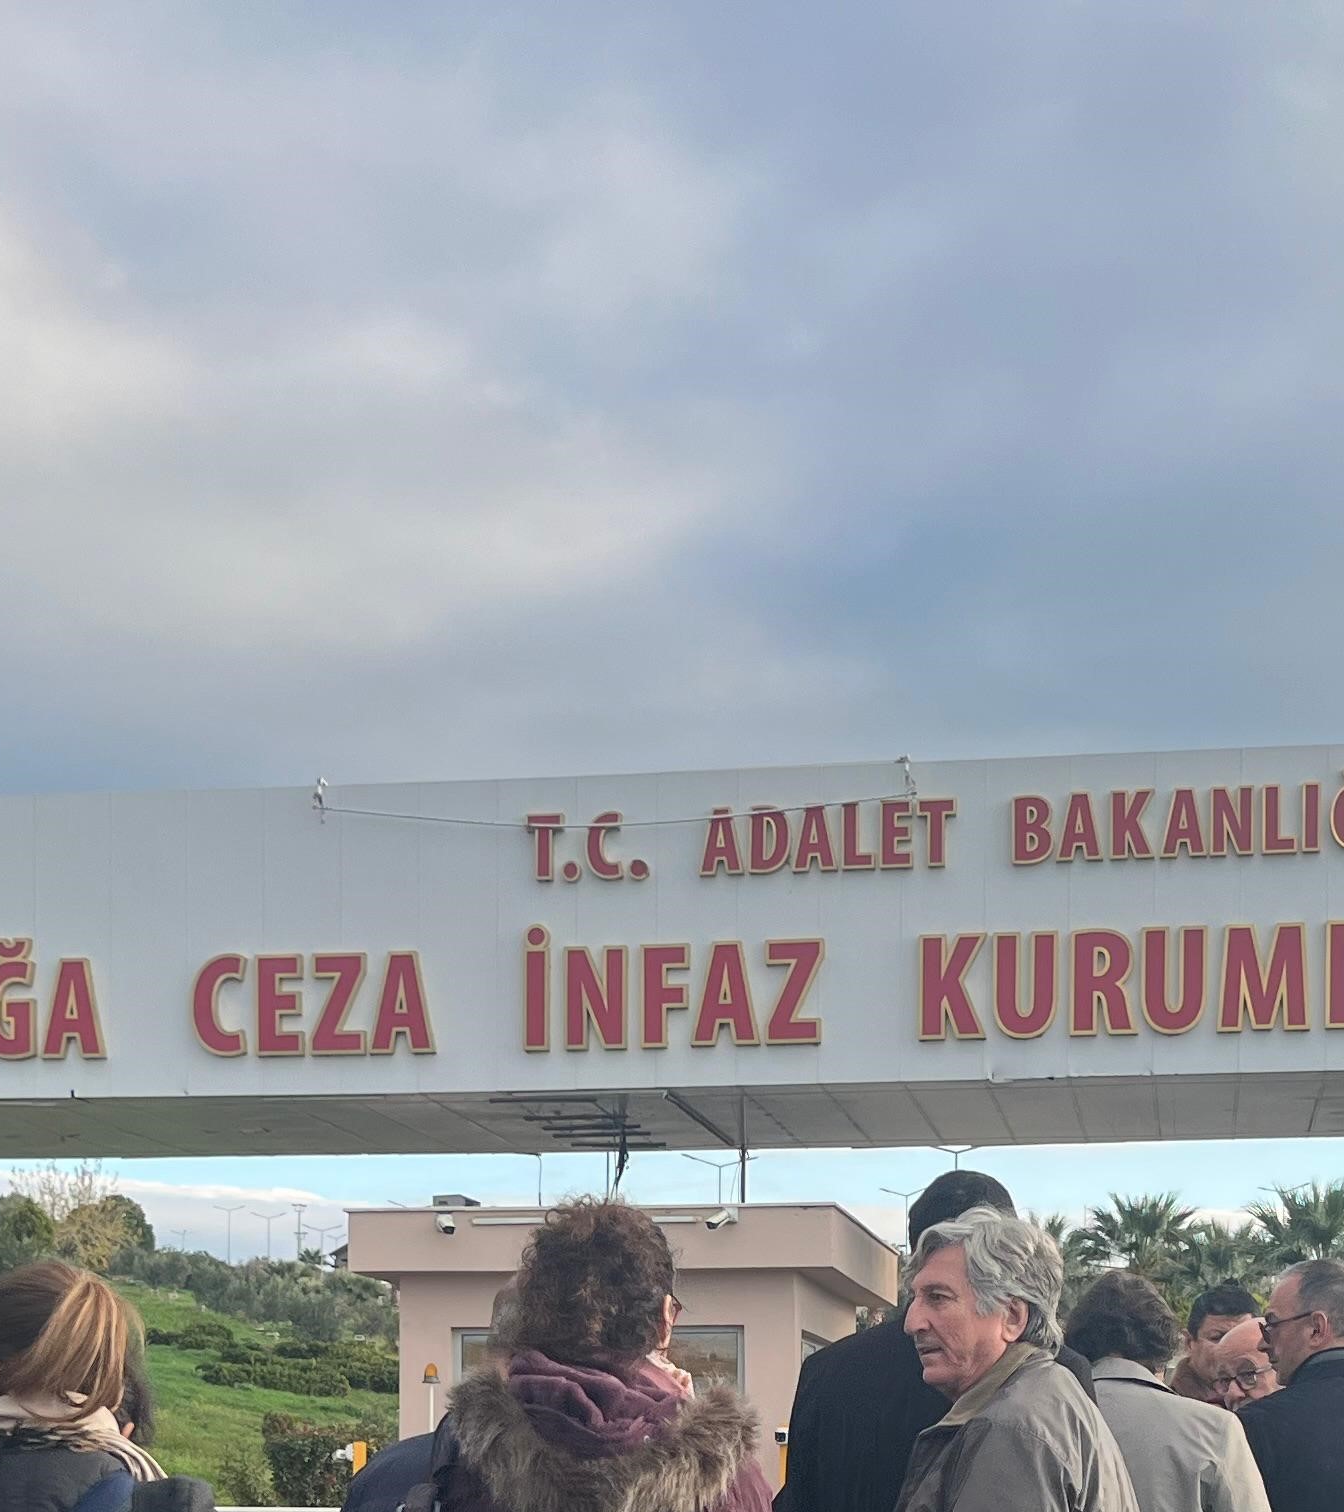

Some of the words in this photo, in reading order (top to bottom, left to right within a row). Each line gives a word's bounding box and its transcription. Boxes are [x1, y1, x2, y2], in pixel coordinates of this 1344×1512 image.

[525, 811, 649, 883] T.C.
[699, 797, 956, 877] ADALET
[189, 951, 437, 1058] CEZA
[523, 923, 824, 1052] İNFAZ
